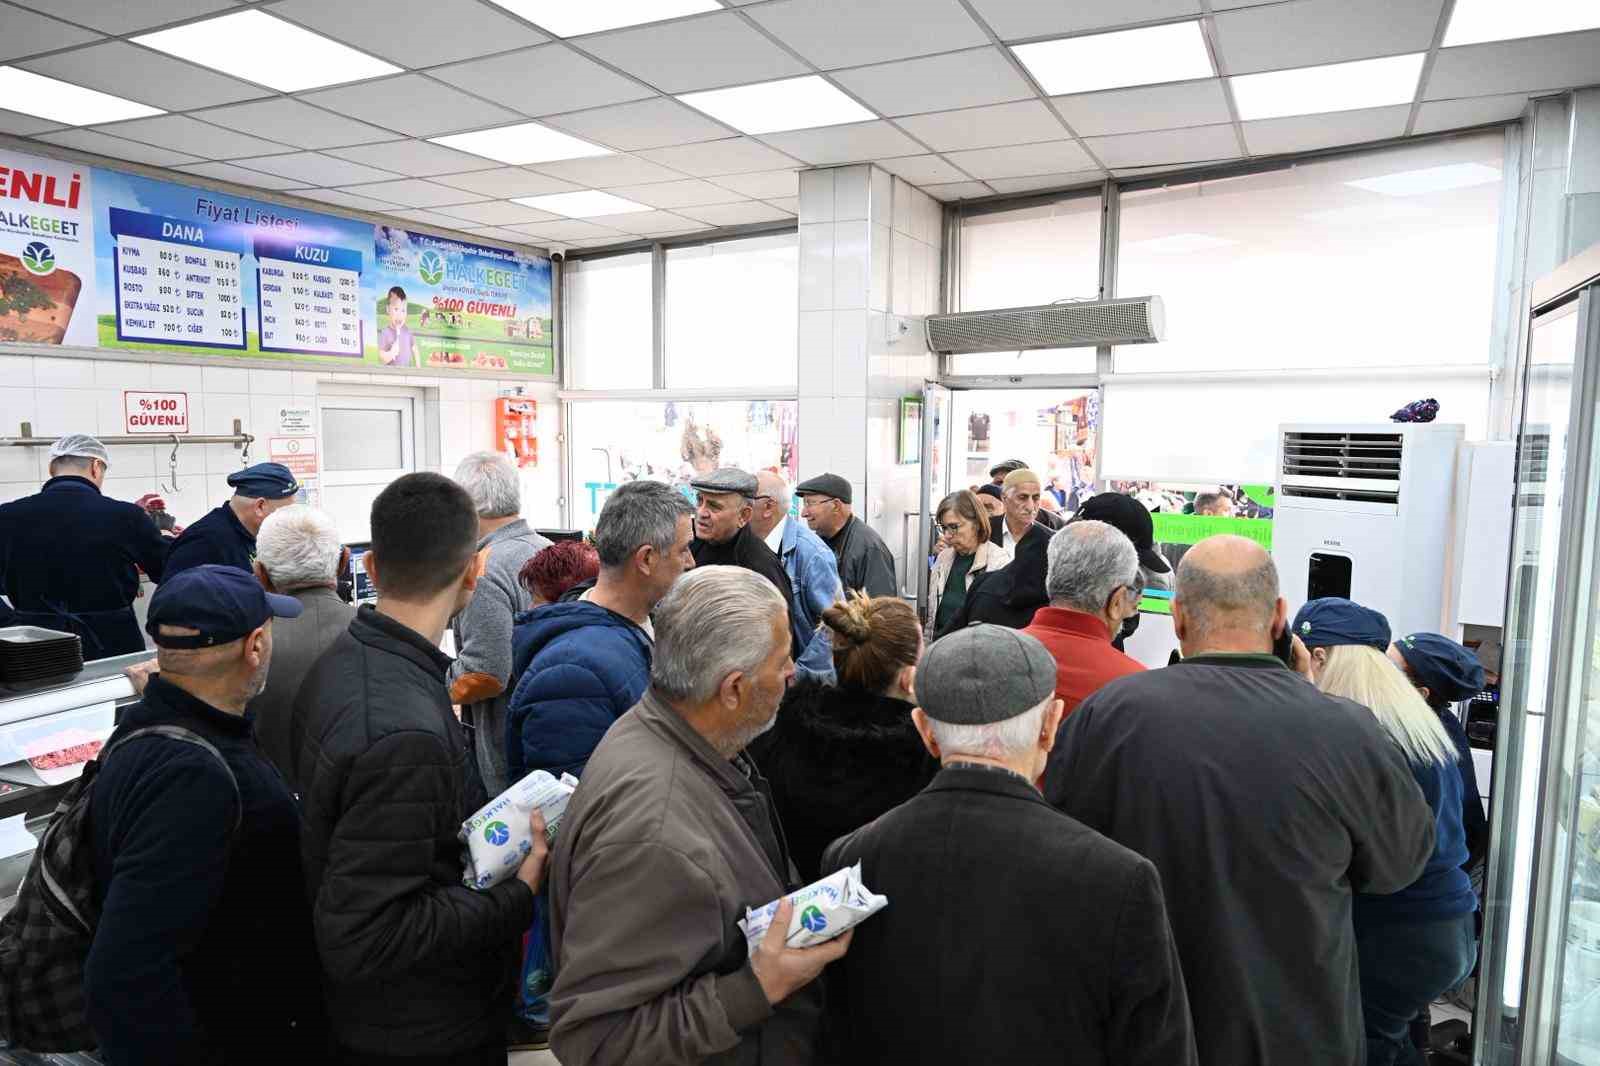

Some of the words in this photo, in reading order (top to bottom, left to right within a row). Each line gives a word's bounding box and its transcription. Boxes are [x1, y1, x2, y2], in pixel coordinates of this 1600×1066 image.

[196, 197, 240, 223] Fiyat
[244, 206, 298, 232] Listesi
[162, 222, 204, 243] DANA
[295, 245, 329, 262] KUZU
[446, 261, 528, 289] HALKEGEET
[162, 304, 174, 313] 920
[432, 295, 464, 312] %100
[467, 298, 517, 318] GÜVENLİ
[139, 399, 176, 411] %100
[129, 411, 185, 426] GÜVENLİ
